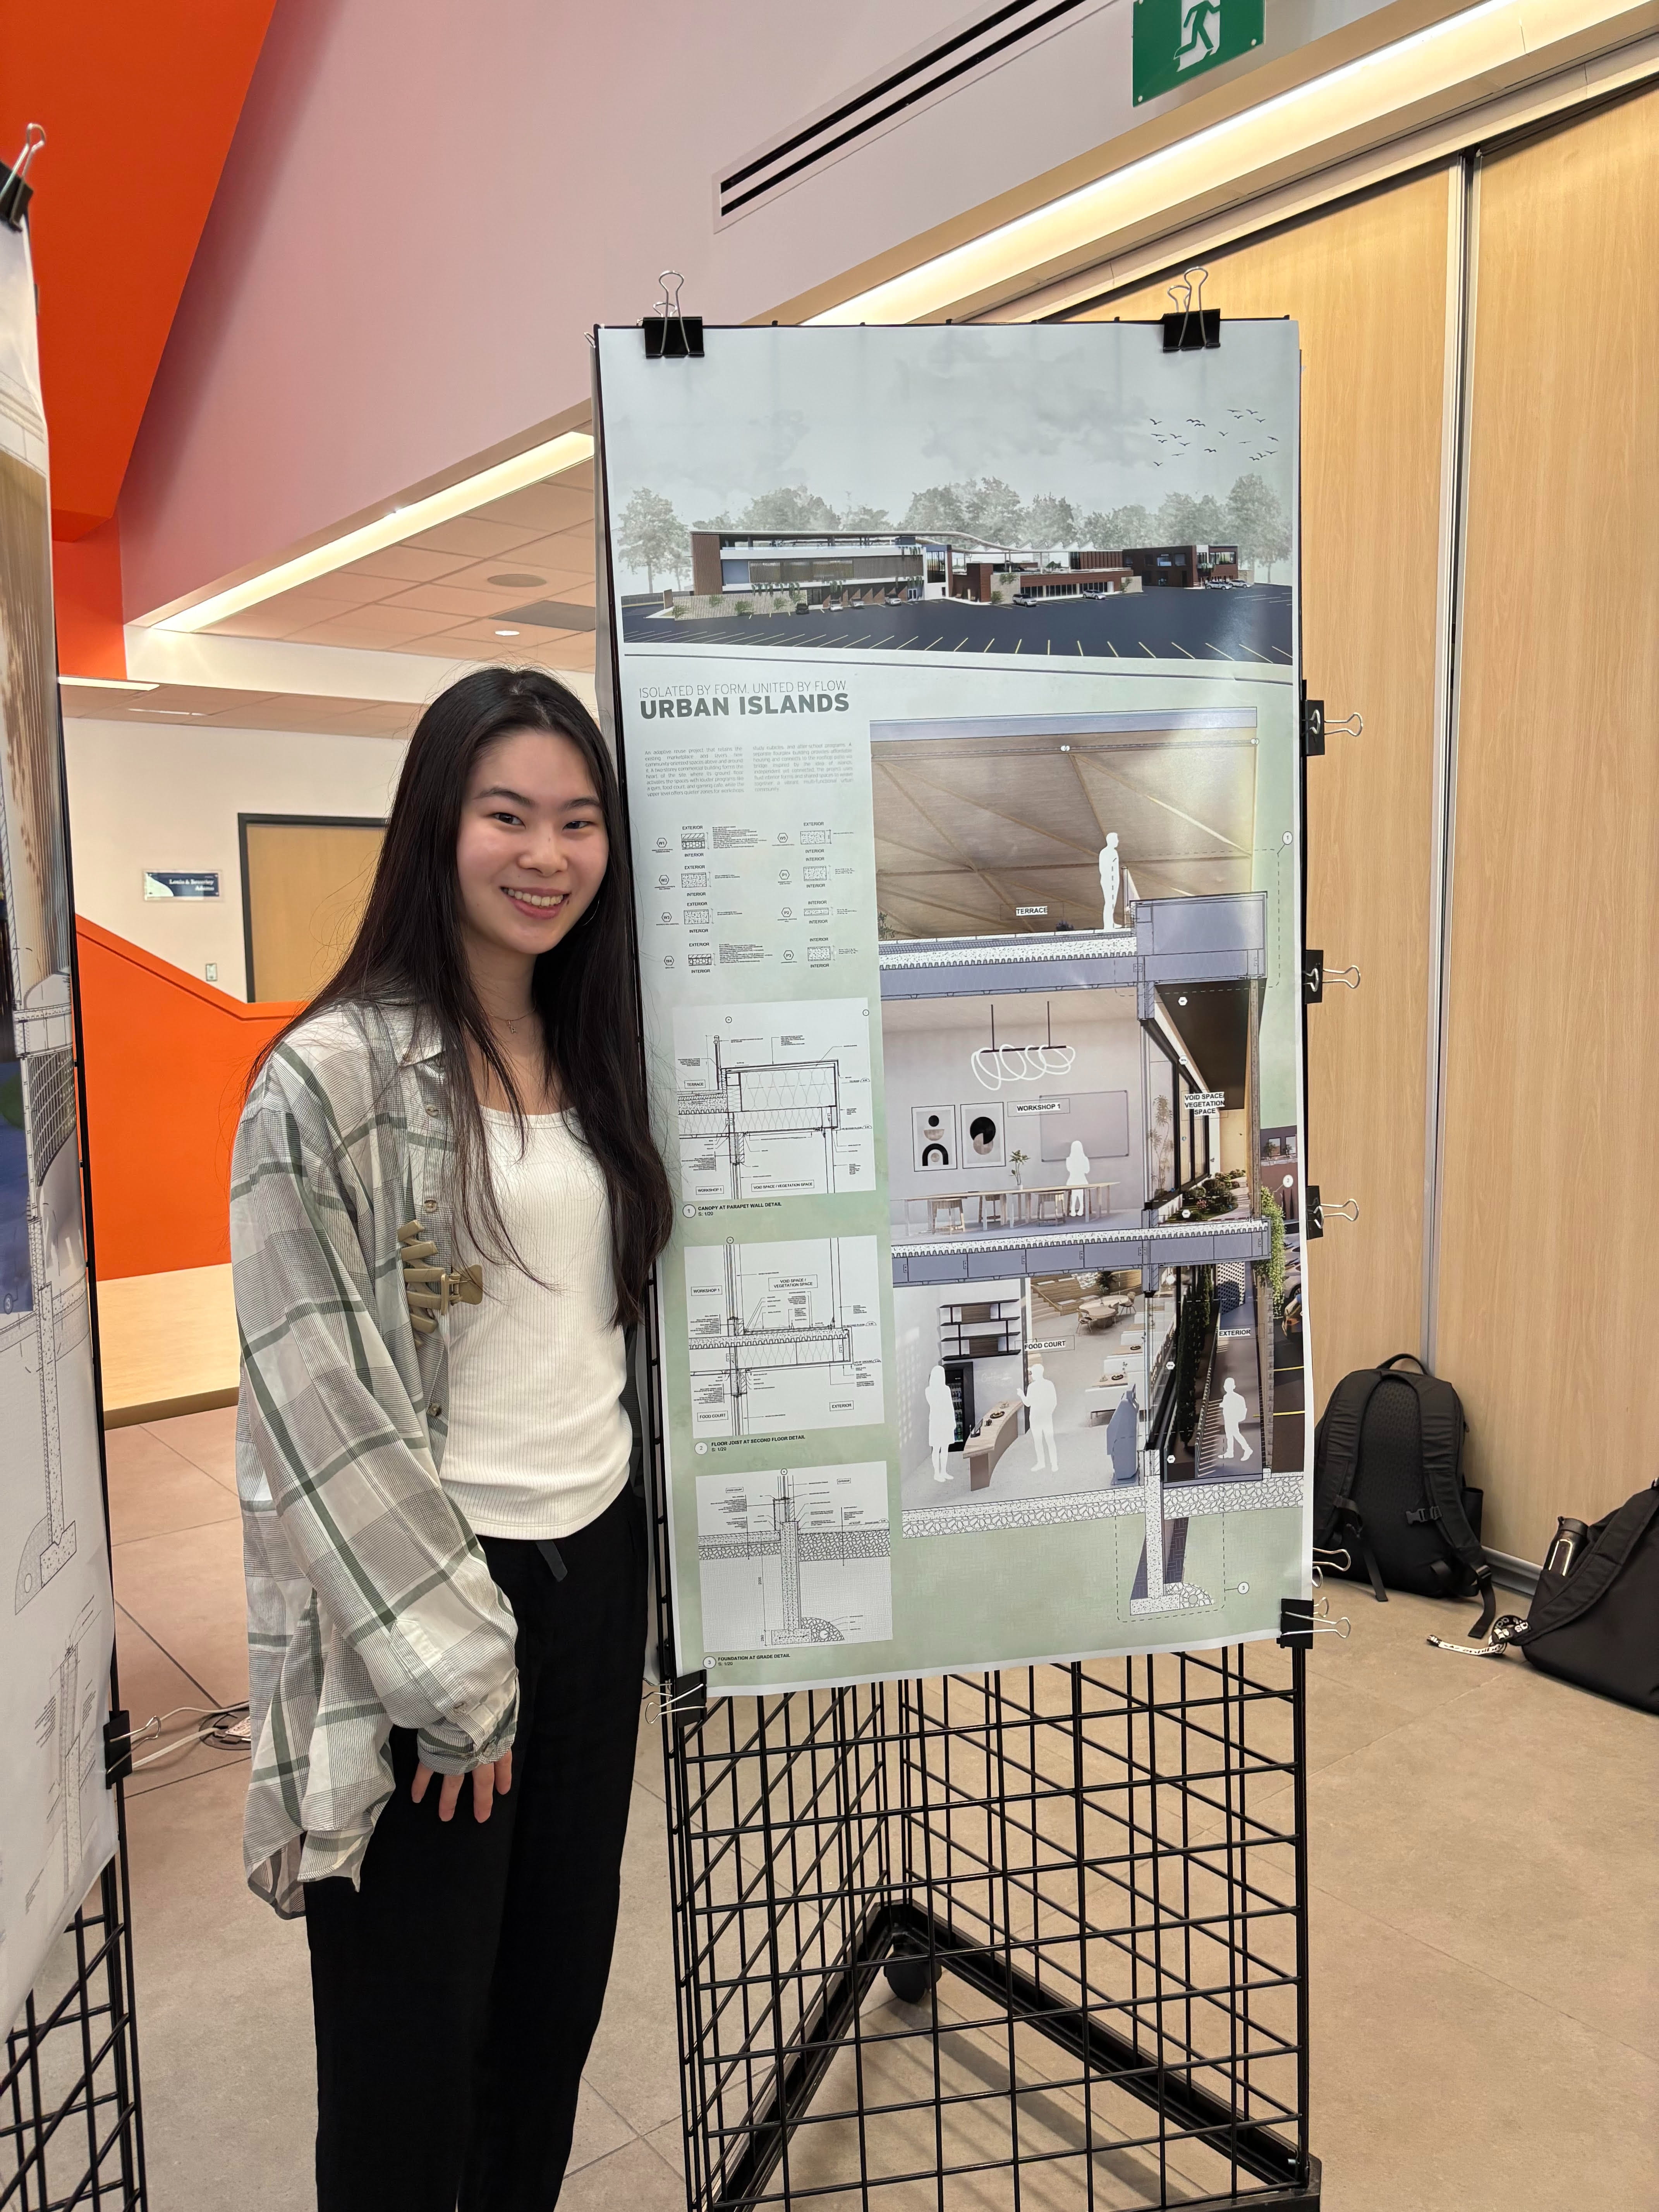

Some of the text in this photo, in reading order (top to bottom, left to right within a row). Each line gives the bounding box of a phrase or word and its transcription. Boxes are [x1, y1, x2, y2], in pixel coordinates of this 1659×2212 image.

[640, 685, 693, 698] ISOLATED
[698, 685, 711, 695] BY
[715, 683, 749, 695] FORM.
[753, 682, 793, 694] UNITED
[798, 682, 811, 692] BY
[641, 693, 849, 719] URBAN ISLANDS
[6, 1298, 11, 1309] 3
